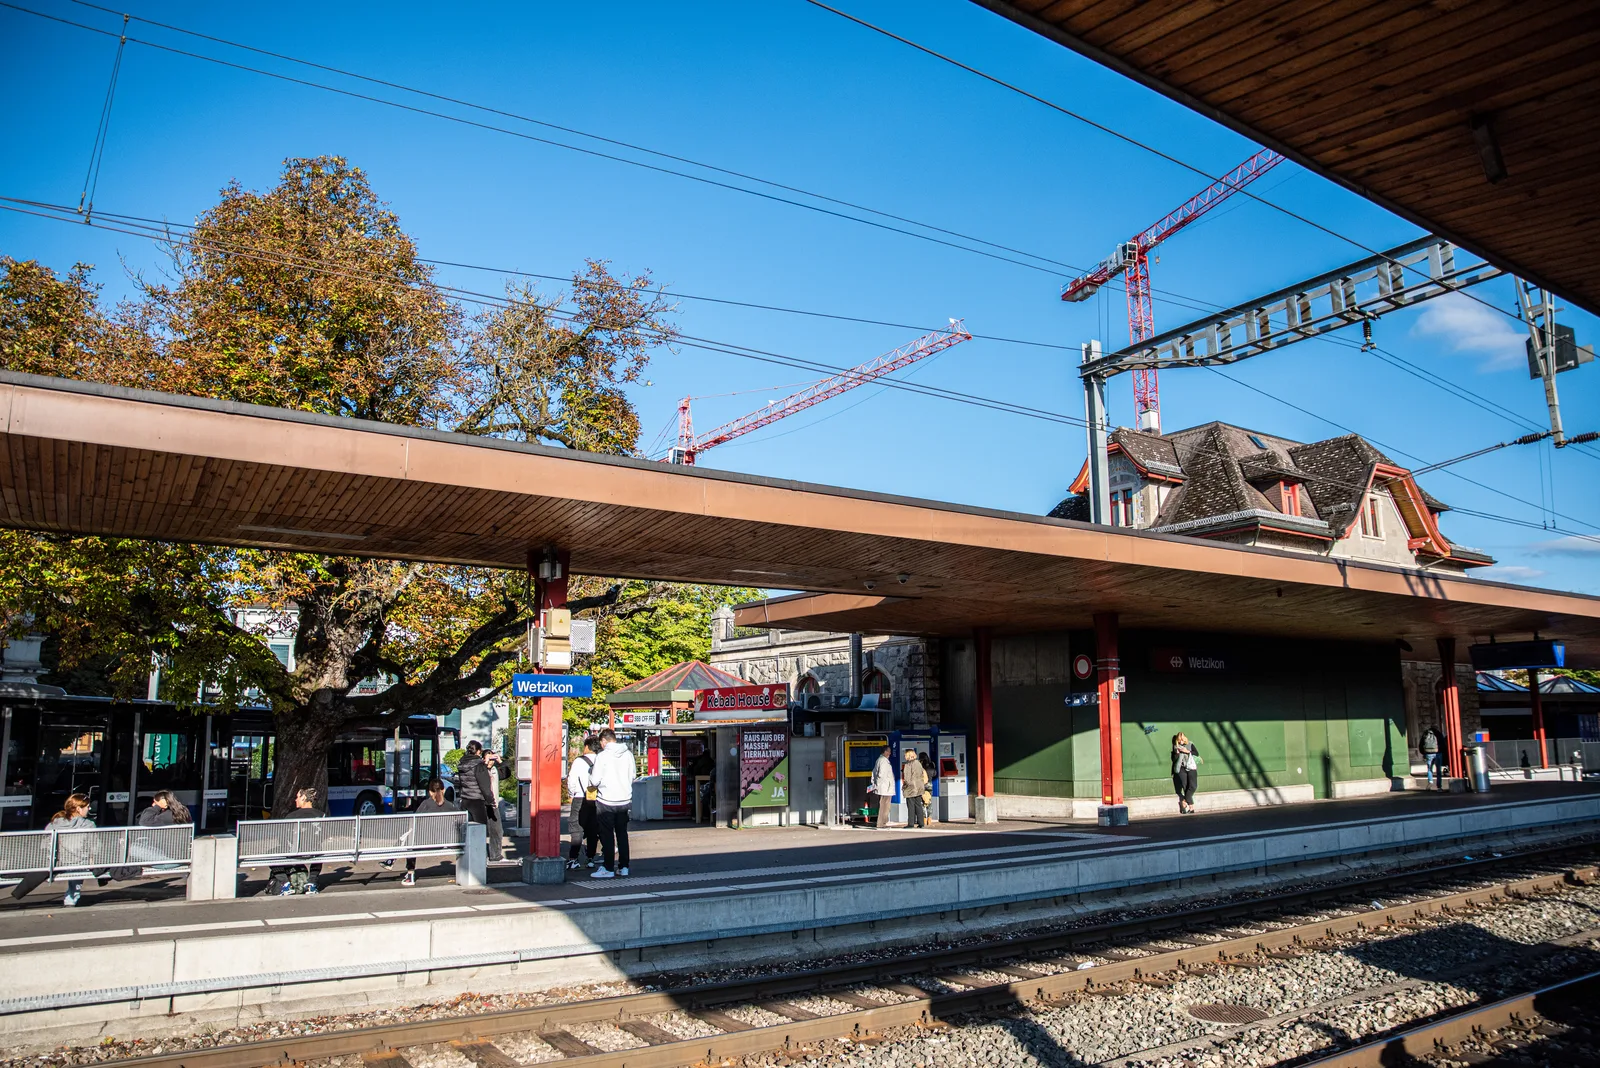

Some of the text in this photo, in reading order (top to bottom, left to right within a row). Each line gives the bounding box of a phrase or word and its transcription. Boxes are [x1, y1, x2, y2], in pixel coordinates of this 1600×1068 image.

[1188, 656, 1225, 669] Wetzikon
[517, 681, 573, 693] Wetzikon
[707, 693, 770, 708] Kebab House
[744, 734, 760, 742] RAUS
[744, 742, 771, 750] MASSEN-
[744, 750, 785, 758] TIERHALTUNG
[771, 786, 785, 798] JA
